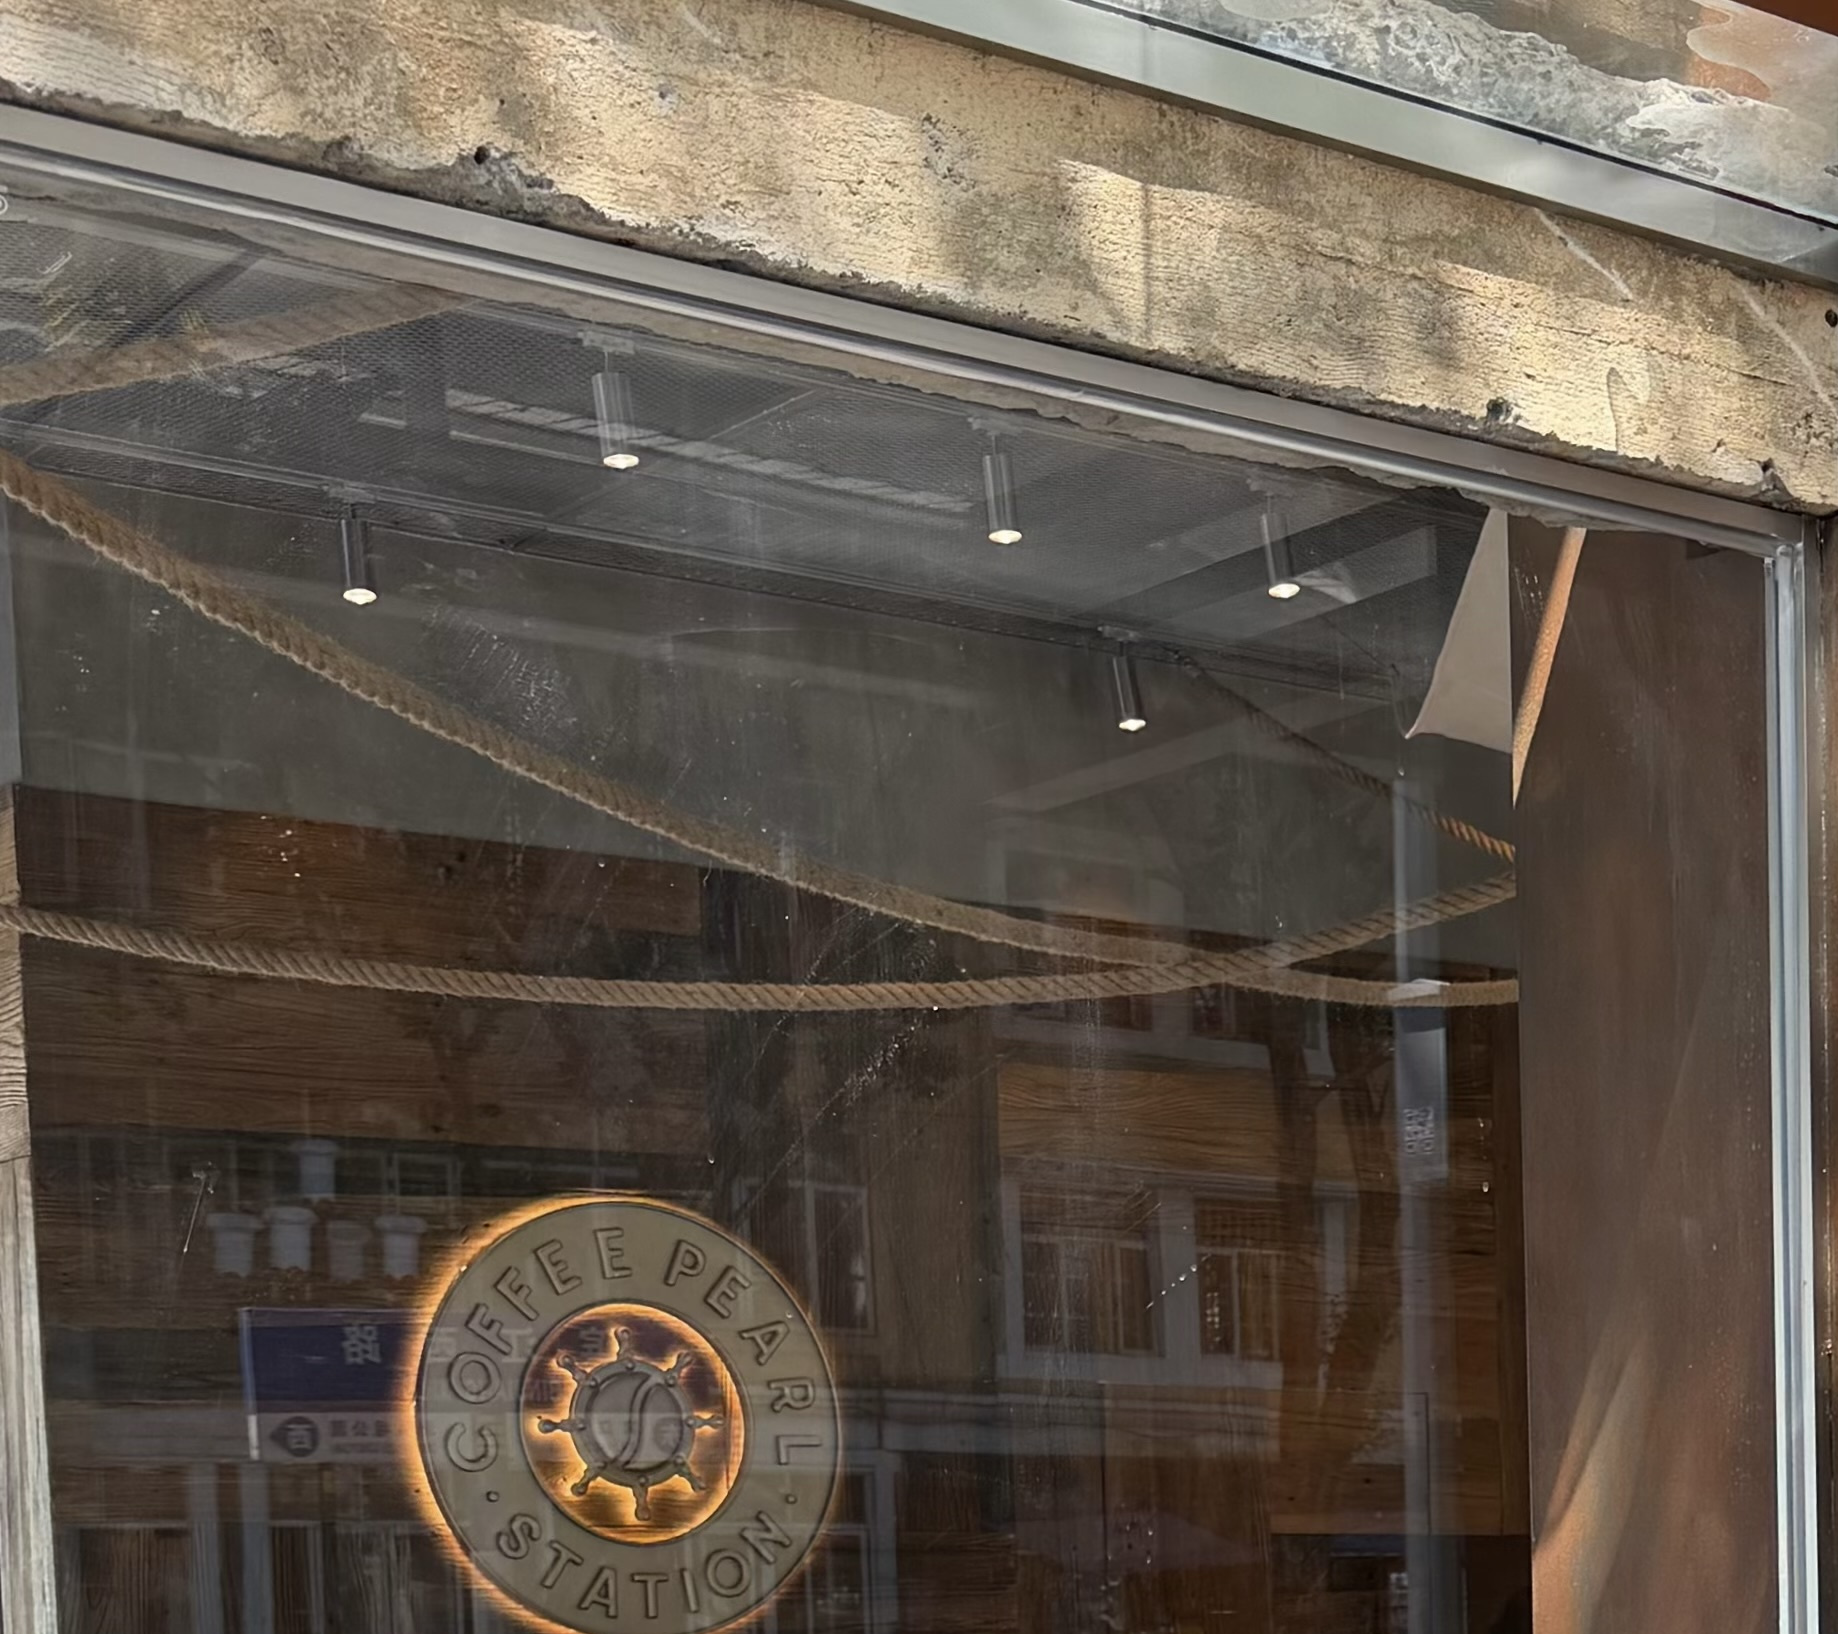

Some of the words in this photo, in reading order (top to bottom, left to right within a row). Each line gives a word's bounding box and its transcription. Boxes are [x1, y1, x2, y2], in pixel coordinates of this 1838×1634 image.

[446, 1227, 633, 1473] COFFEE
[663, 1239, 822, 1465] PEARL
[497, 1511, 793, 1620] STATION
